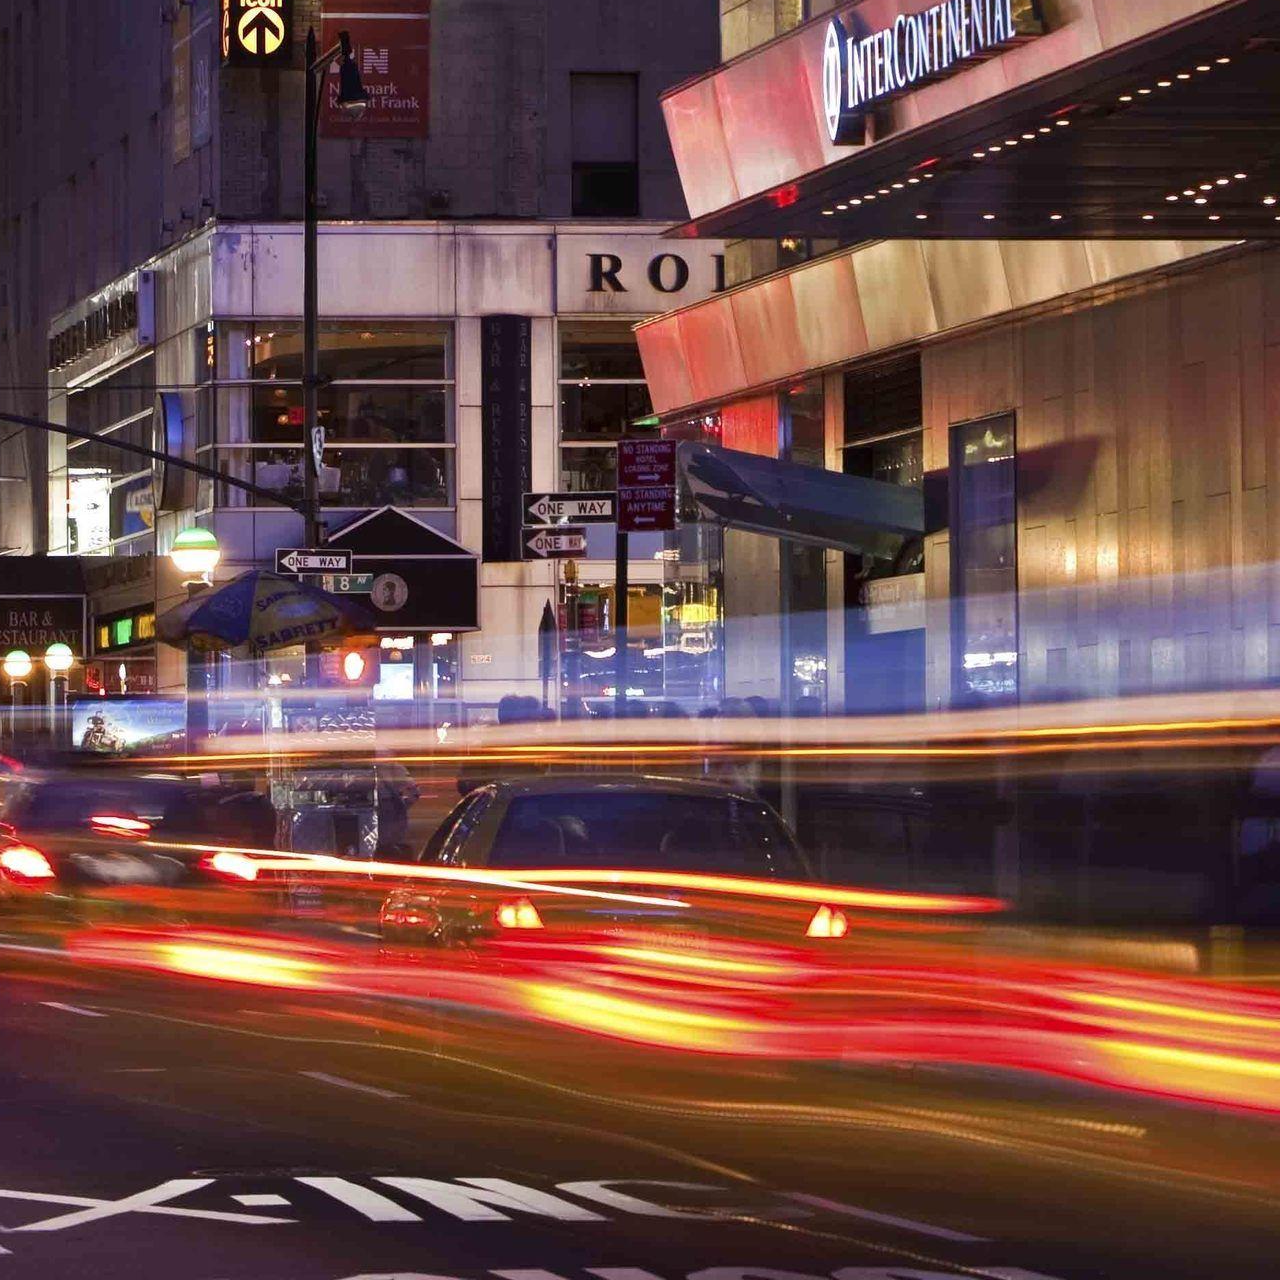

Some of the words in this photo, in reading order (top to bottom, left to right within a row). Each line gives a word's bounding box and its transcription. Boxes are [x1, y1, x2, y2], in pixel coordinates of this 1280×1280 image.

[329, 82, 398, 95] Nmark
[381, 96, 420, 109] Frank
[622, 445, 634, 455] NO
[637, 444, 671, 454] STANDING
[622, 490, 634, 499] NO
[634, 489, 672, 499] STANDING
[537, 502, 564, 515] ONE
[577, 501, 606, 514] WAY
[627, 501, 667, 513] ANYTIME
[535, 537, 562, 550] ONE
[288, 557, 309, 567] ONE
[319, 557, 343, 567] WAY
[339, 576, 350, 591] 8
[357, 576, 367, 584] AV
[8, 611, 39, 627] BAR
[41, 611, 54, 627] &
